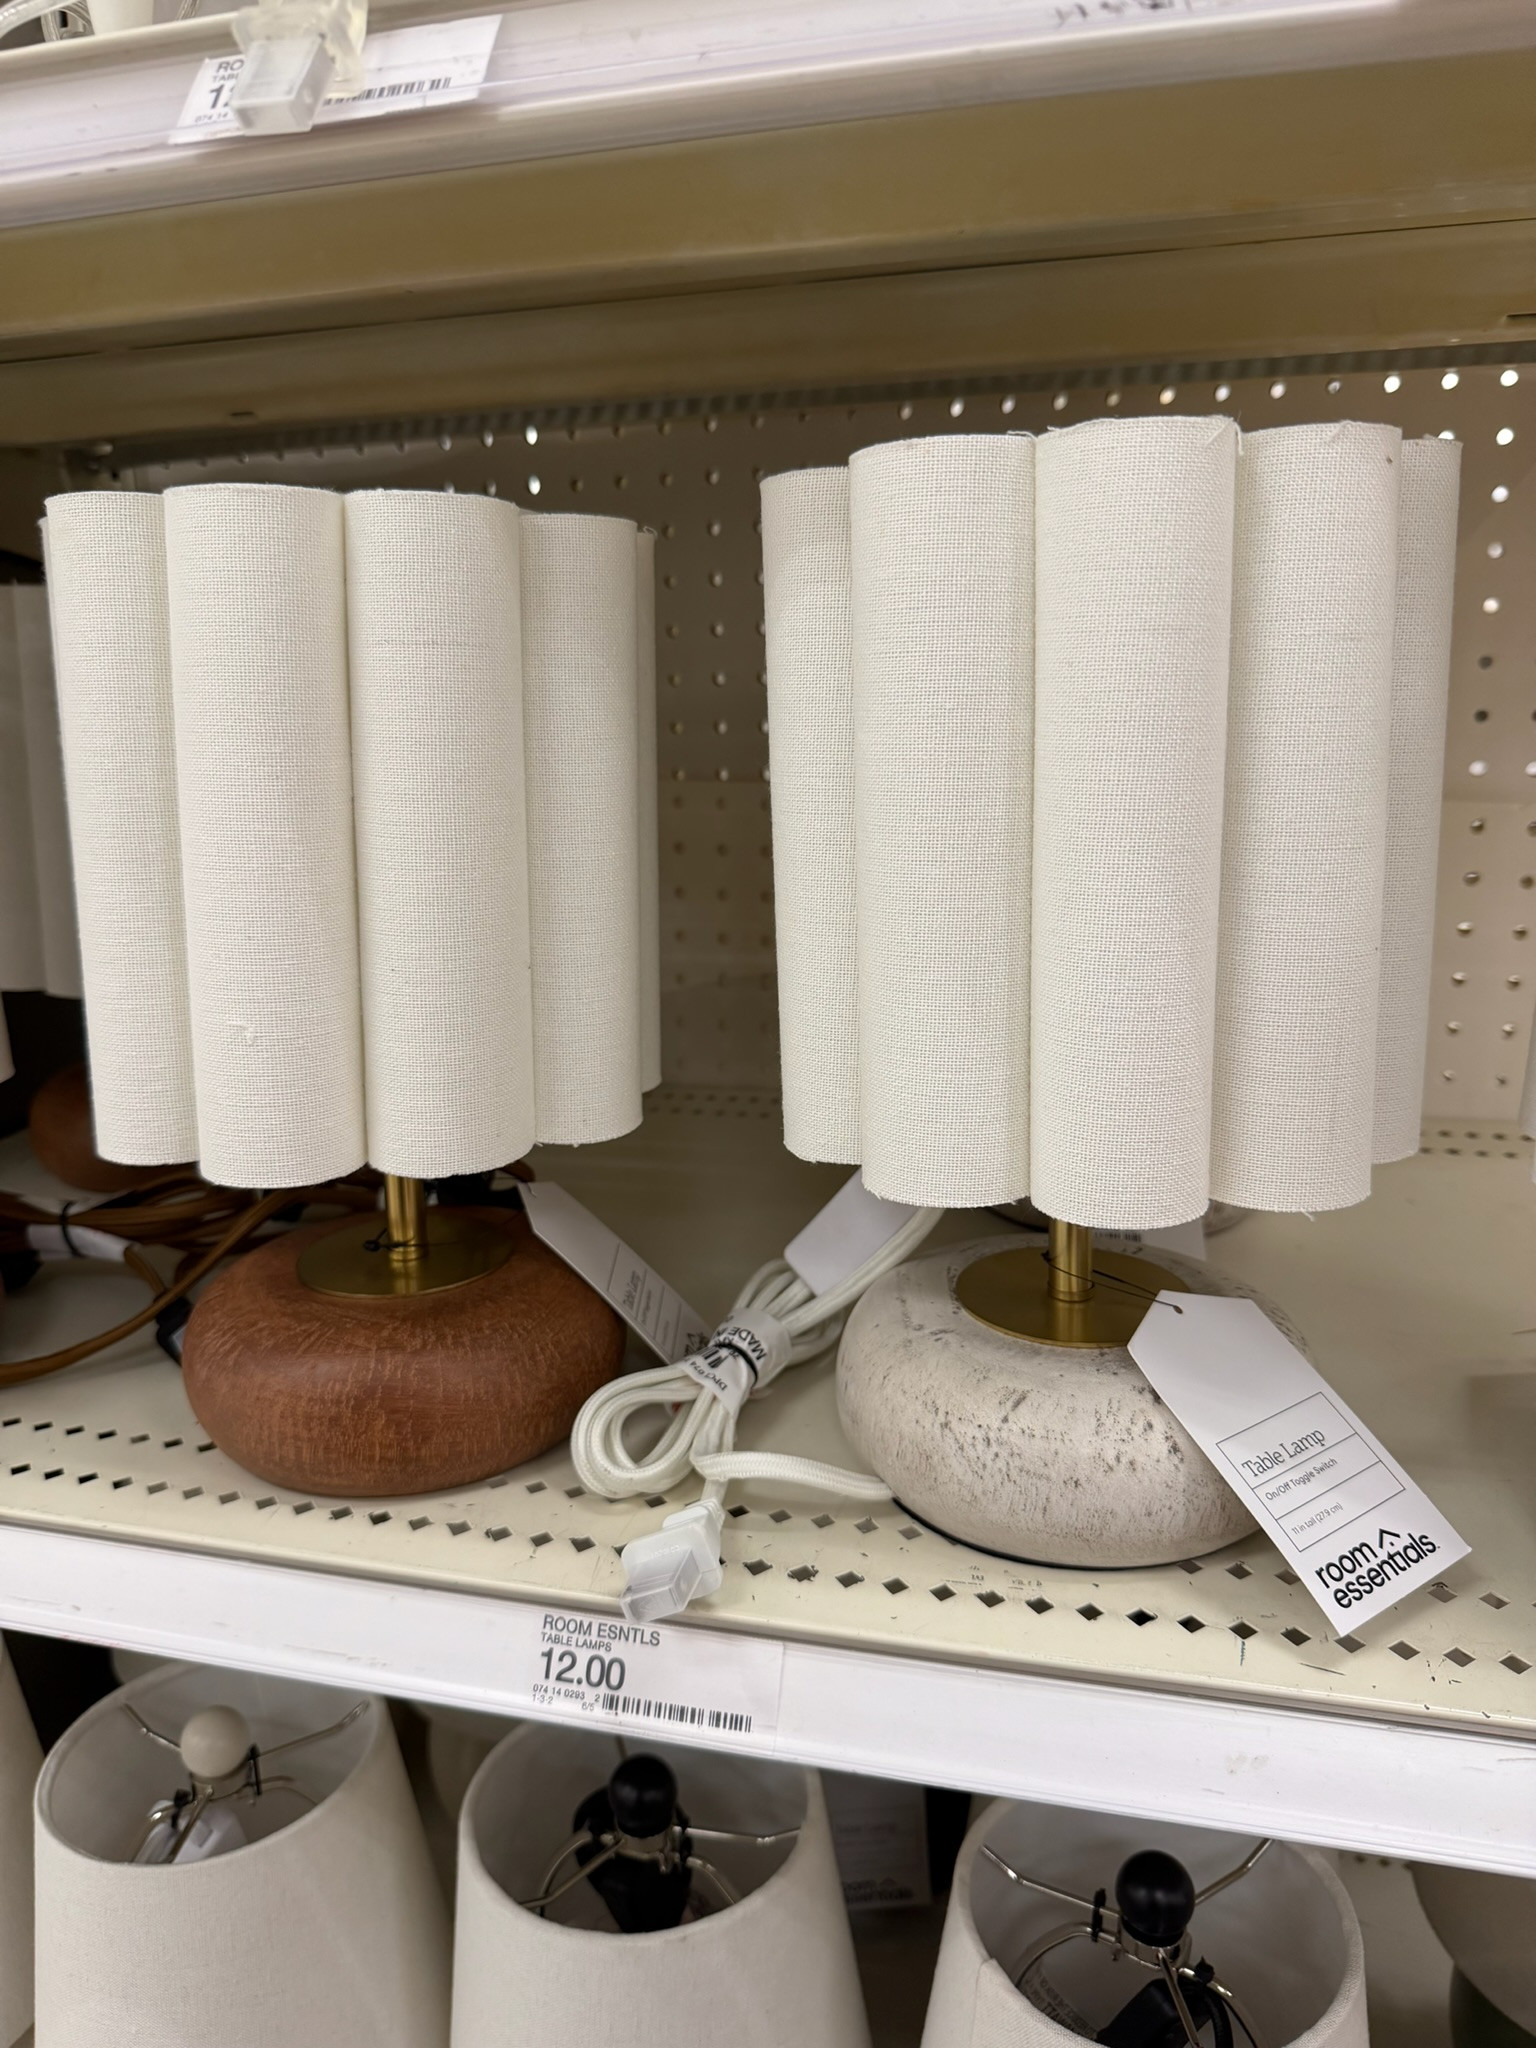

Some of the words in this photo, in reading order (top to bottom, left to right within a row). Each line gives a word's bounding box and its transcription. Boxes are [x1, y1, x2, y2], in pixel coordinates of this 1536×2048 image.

[215, 58, 246, 74] RO
[727, 1326, 768, 1361] MADE
[1241, 1442, 1286, 1478] Table
[1282, 1427, 1326, 1461] Lamp
[1264, 1478, 1292, 1501] On/Off
[1288, 1467, 1317, 1490] Toggle
[1314, 1456, 1338, 1476] Switch
[1329, 1501, 1344, 1518] cm)
[1314, 1540, 1379, 1589] room
[1332, 1532, 1438, 1609] essentials
[541, 1632, 573, 1646] TABLE
[575, 1636, 612, 1652] LAMPS
[542, 1614, 593, 1637] ROOM
[597, 1622, 661, 1646] ESNTLS
[540, 1646, 626, 1691] 12.00
[532, 1684, 549, 1694] 074
[551, 1687, 562, 1697] 14
[564, 1690, 586, 1701] 0293
[594, 1693, 601, 1703] 2
[532, 1693, 554, 1705] 1-3-2
